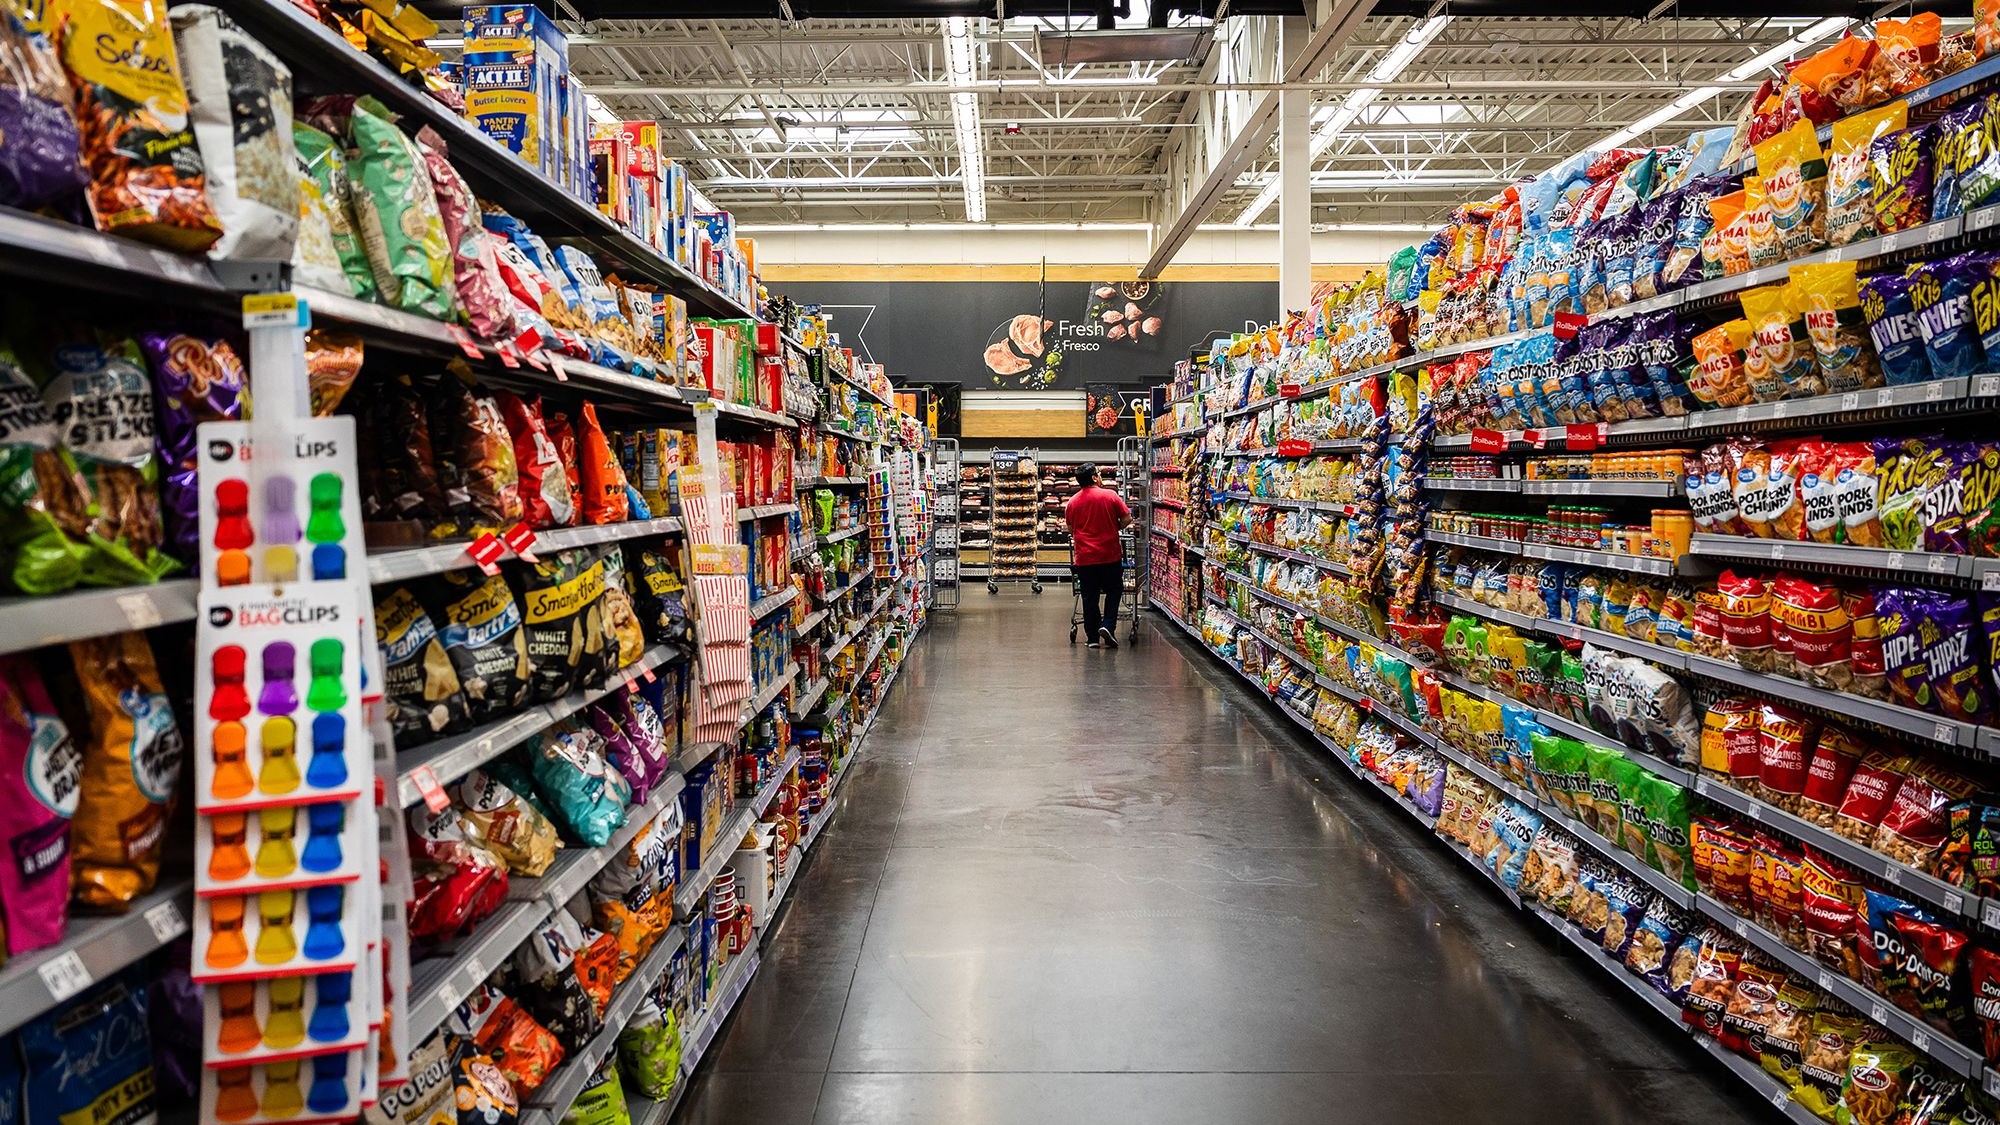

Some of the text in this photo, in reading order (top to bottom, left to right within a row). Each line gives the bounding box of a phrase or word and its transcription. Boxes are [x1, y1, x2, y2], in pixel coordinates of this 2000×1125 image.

[485, 28, 501, 36] ACT
[475, 70, 523, 84] ACT II
[474, 95, 527, 107] Butter Lovers
[484, 117, 520, 126] PANTRY
[490, 124, 514, 132] PACK
[1059, 320, 1104, 337] Fresh
[1758, 327, 1791, 347] MAC'S
[1062, 340, 1100, 351] Fresco
[1701, 356, 1730, 375] MAC'S
[1473, 436, 1498, 446] Rollback
[1567, 433, 1593, 441] Rollback
[682, 484, 702, 495] BOXES
[1837, 486, 1872, 503] PORK
[1805, 493, 1834, 509] PORK
[1925, 478, 1967, 527] STIX
[467, 613, 508, 645] Party
[534, 631, 567, 642] WHITE
[472, 646, 507, 661] WHITE
[1700, 996, 1724, 1011] SPICY
[1866, 1075, 1886, 1088] ONLY
